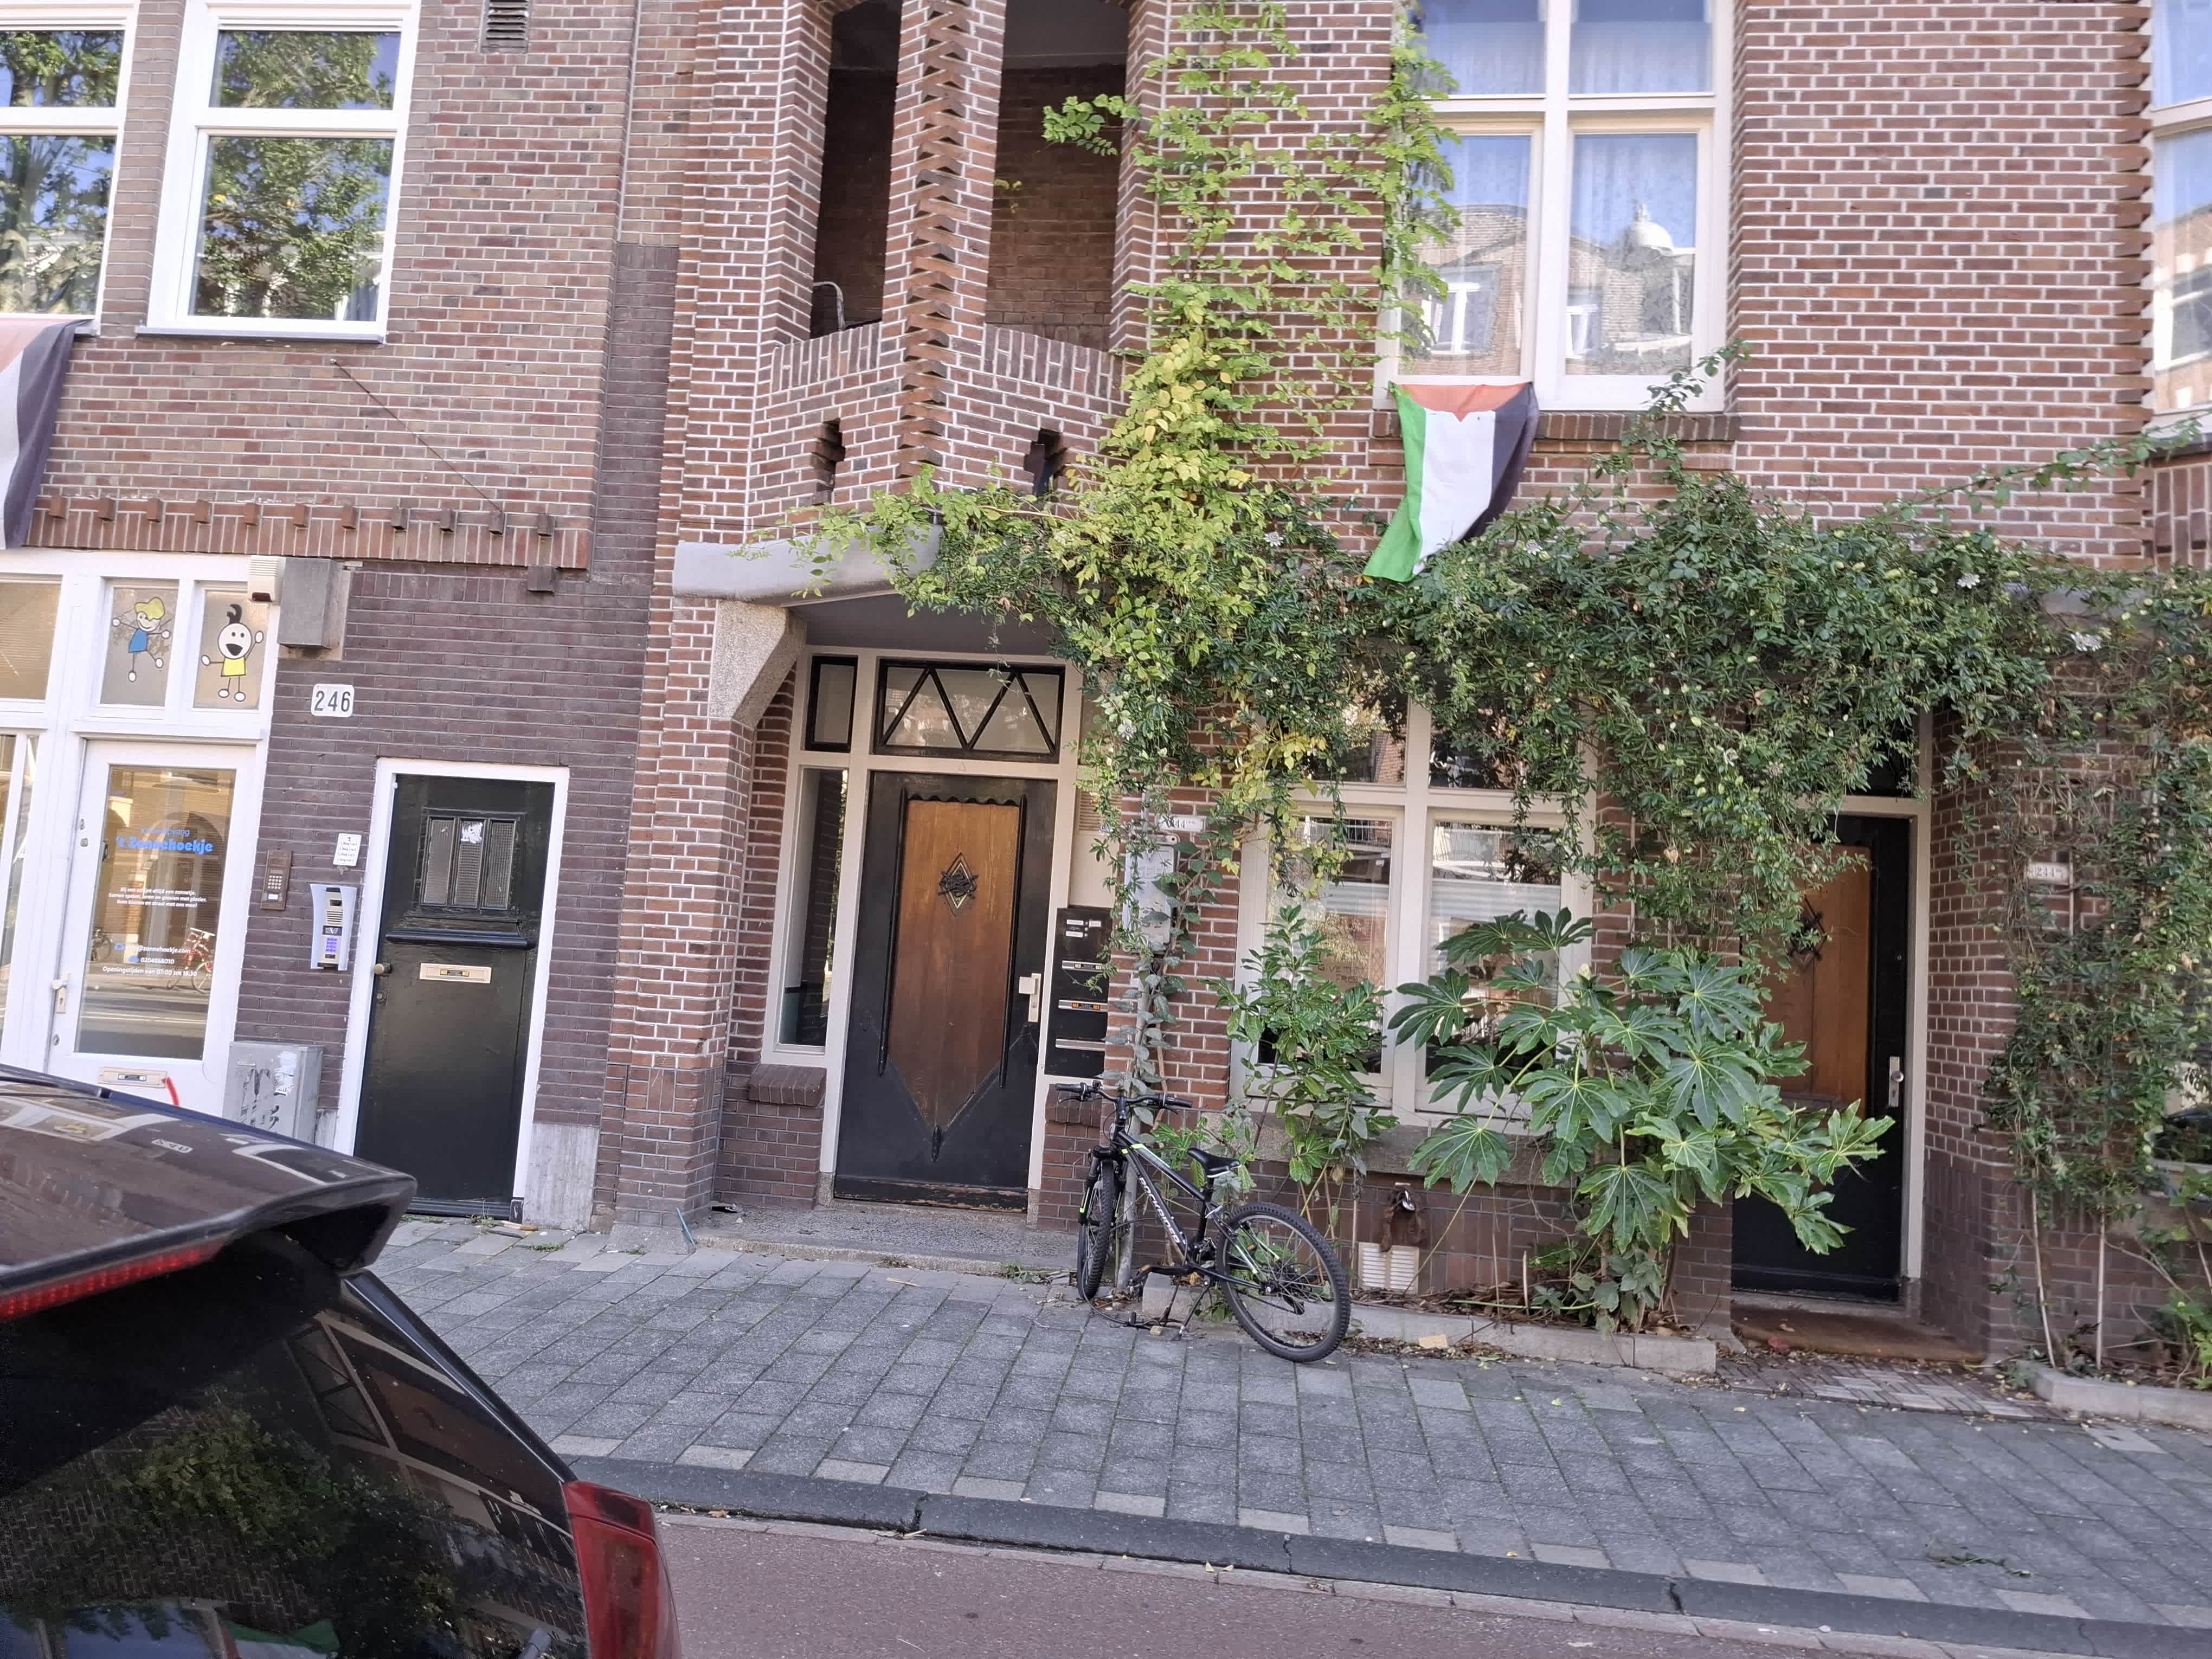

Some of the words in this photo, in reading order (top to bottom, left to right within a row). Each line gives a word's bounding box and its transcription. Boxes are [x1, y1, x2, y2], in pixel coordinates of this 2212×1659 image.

[314, 690, 351, 712] 246
[126, 944, 191, 954] o@zonnehoekje.com
[102, 966, 144, 975] Openingstijden
